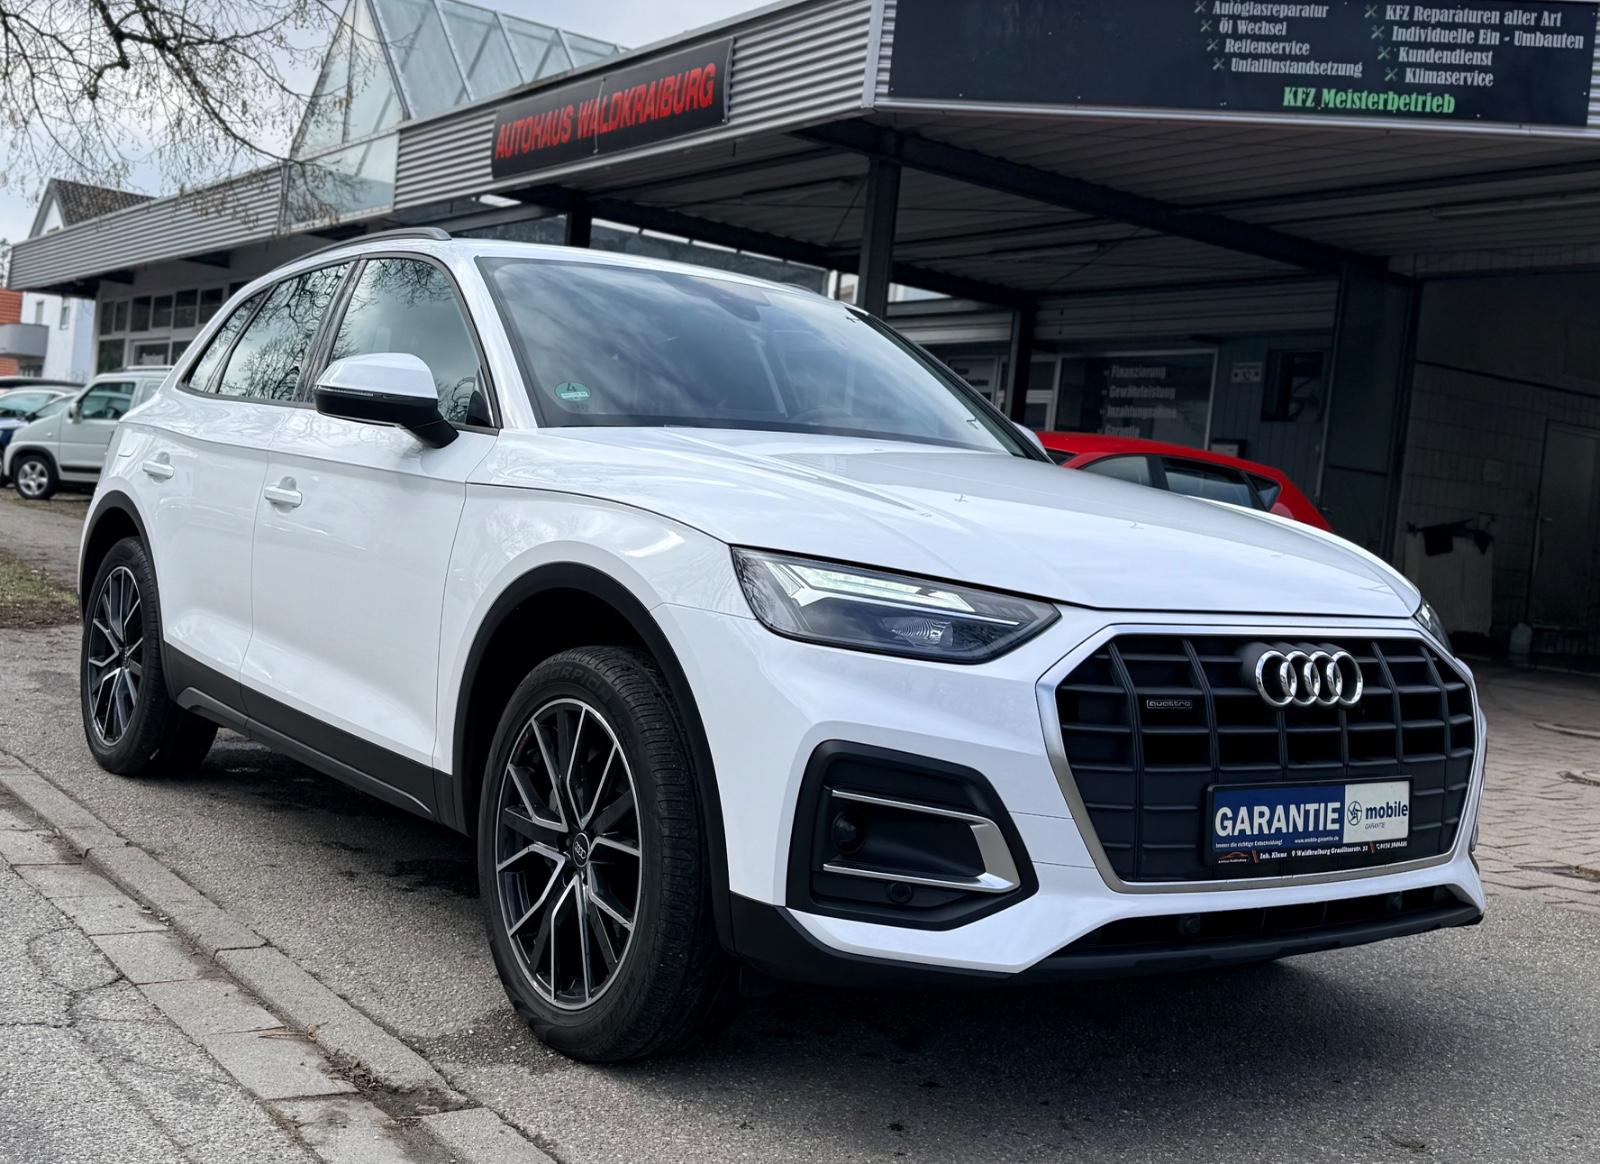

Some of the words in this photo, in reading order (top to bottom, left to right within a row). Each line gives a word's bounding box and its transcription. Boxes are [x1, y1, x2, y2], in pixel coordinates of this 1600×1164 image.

[1212, 1, 1329, 19] Autoglasreparatur
[1384, 5, 1410, 22] KFZ
[1412, 6, 1500, 25] Reparaturen
[1503, 9, 1538, 26] aller
[1541, 10, 1562, 27] Art
[1218, 17, 1233, 34] Öl
[1237, 19, 1287, 36] Wechsel
[1224, 38, 1310, 56] Reifenservice
[1391, 25, 1475, 44] Individuelle
[1478, 29, 1500, 46] Ein
[1513, 30, 1584, 50] Umbauten
[1398, 47, 1493, 66] Kundendienst
[1231, 57, 1363, 78] Unfallinstandsetzung
[1404, 68, 1494, 87] Klimaservice
[1282, 86, 1315, 107] KFZ
[1320, 88, 1456, 114] Meisterbetrieb
[494, 104, 574, 160] AUTOHAUS
[577, 62, 717, 140] WALDKRAIBURG
[1215, 802, 1341, 837] GARANTIE
[1365, 800, 1409, 820] mobile
